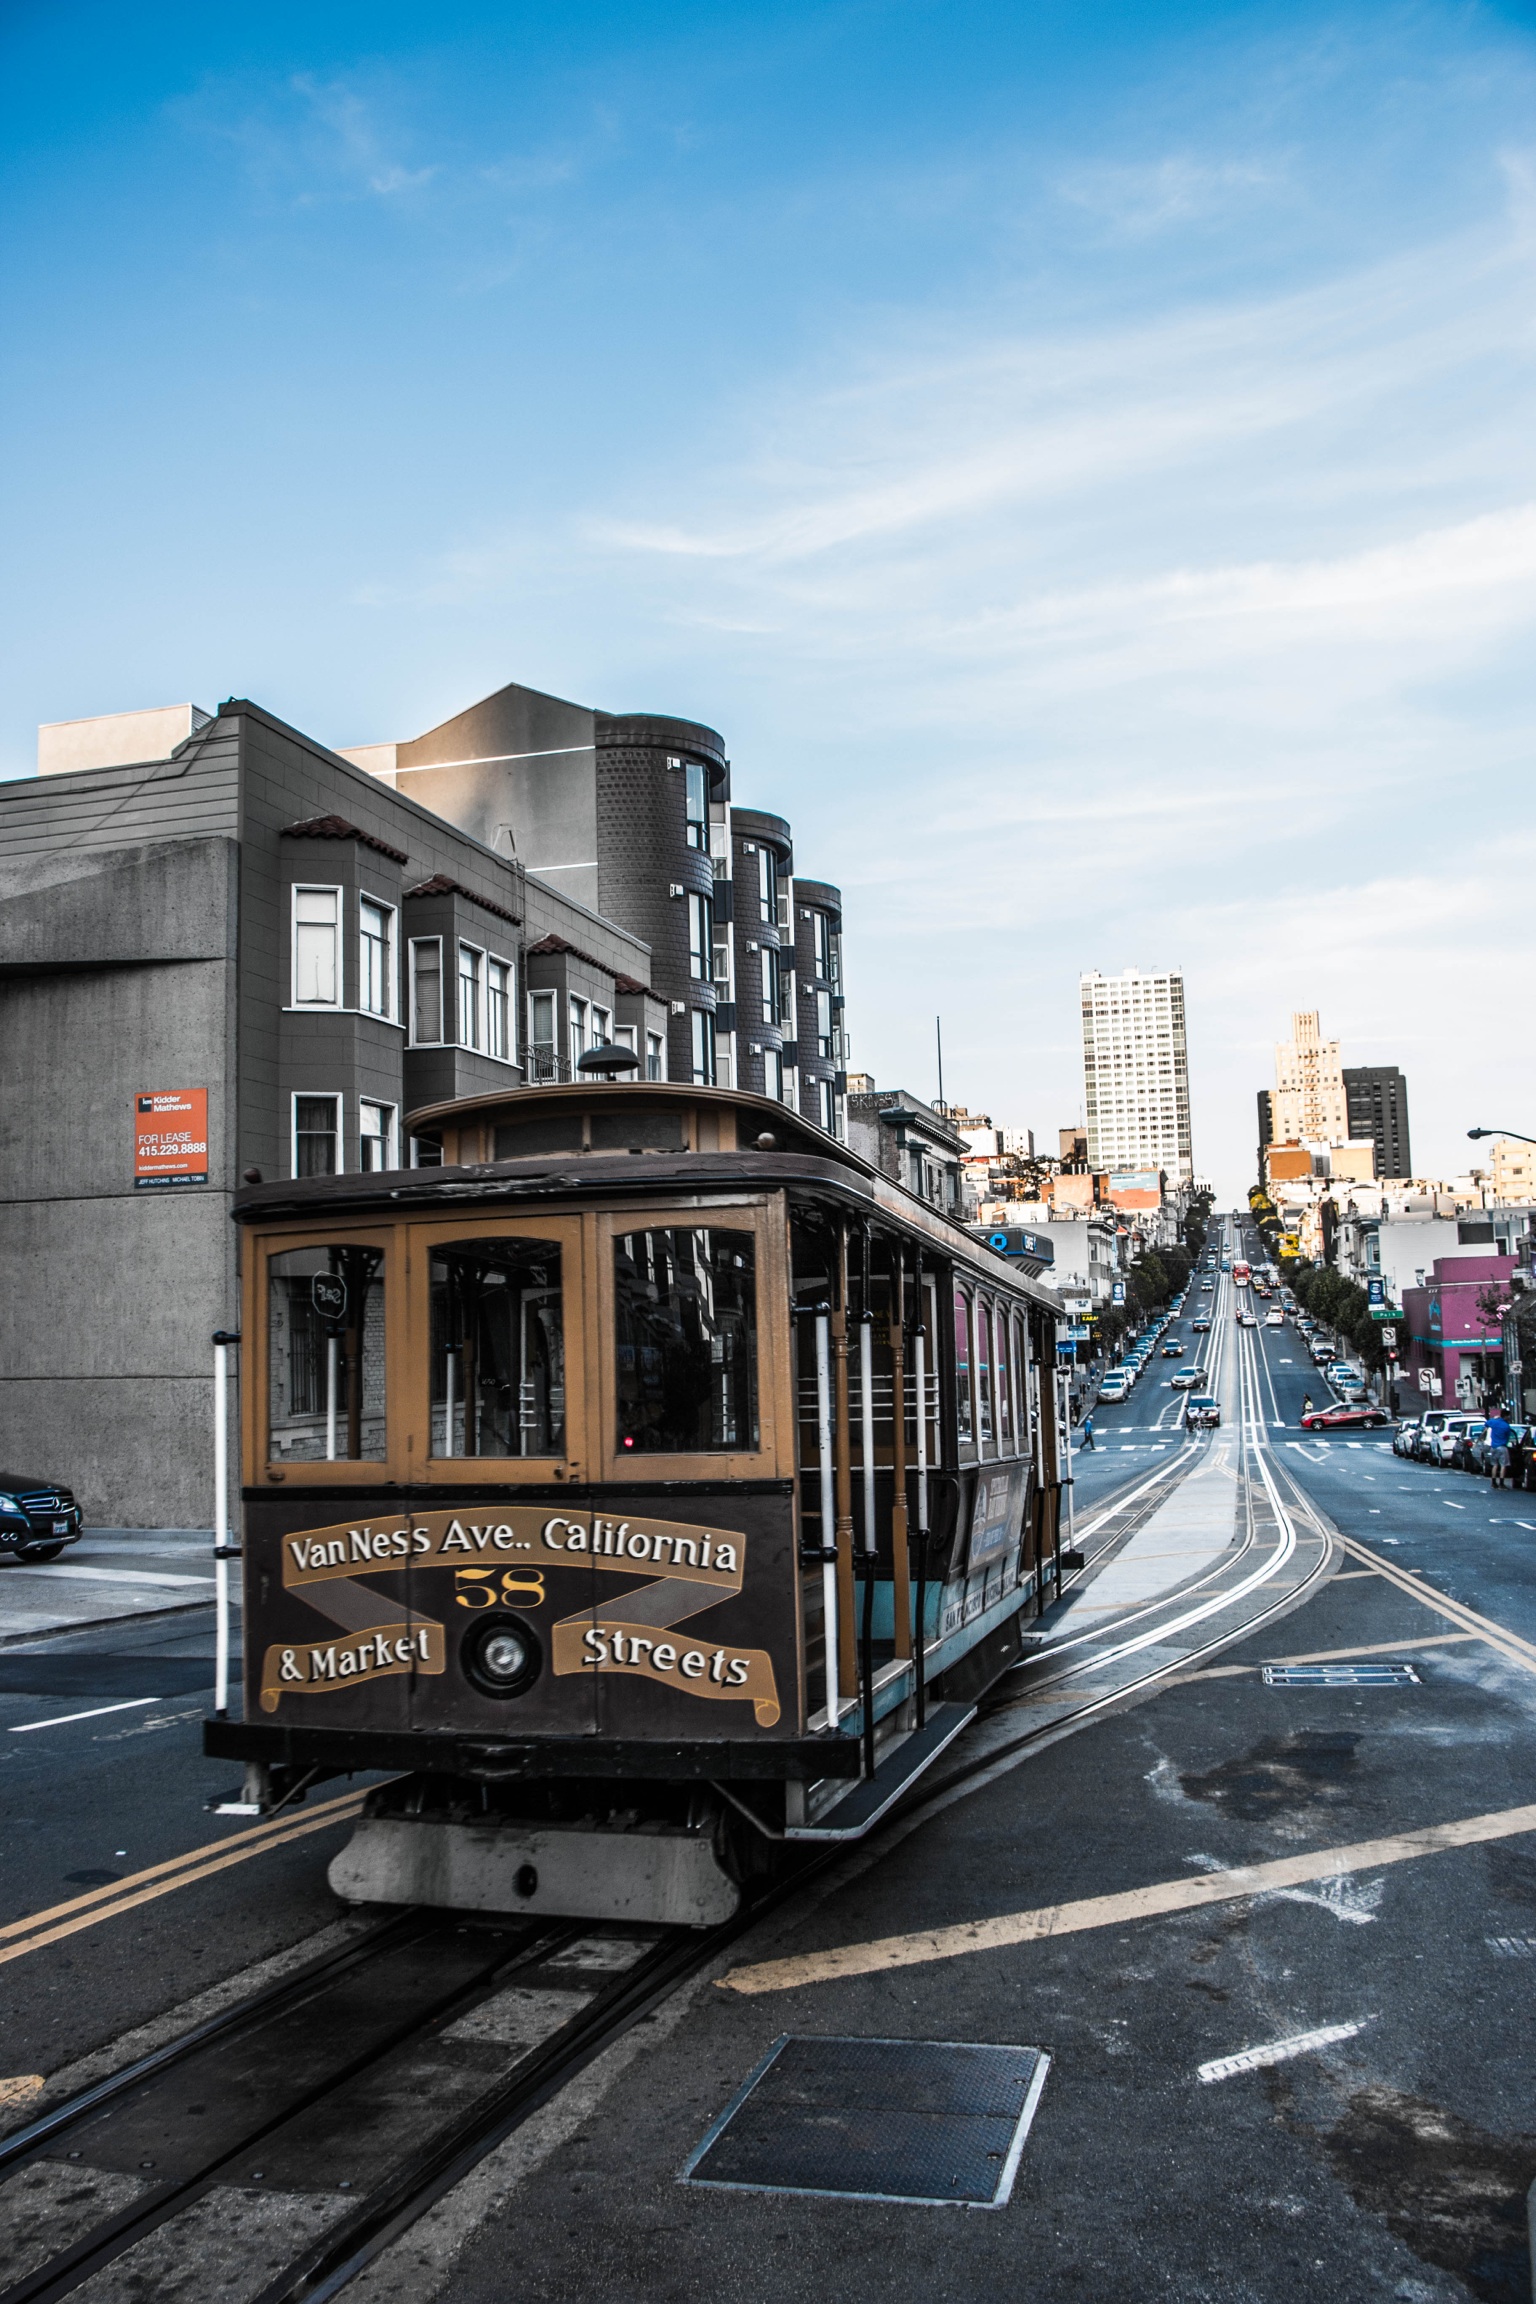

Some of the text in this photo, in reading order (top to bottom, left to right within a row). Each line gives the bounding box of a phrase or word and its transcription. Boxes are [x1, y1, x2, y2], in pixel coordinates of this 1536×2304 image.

[154, 1096, 180, 1104] Kidder
[154, 1104, 191, 1112] Mathews
[139, 1132, 191, 1145] FOR LEASE
[139, 1143, 206, 1156] 415.229.8888
[139, 1163, 188, 1171] kiddermathews.com
[291, 1537, 346, 1572] Van
[349, 1526, 431, 1562] Ness
[543, 1517, 739, 1572] California
[454, 1568, 546, 1609] 58
[280, 1630, 430, 1682] & Market
[584, 1629, 750, 1684] Streets
